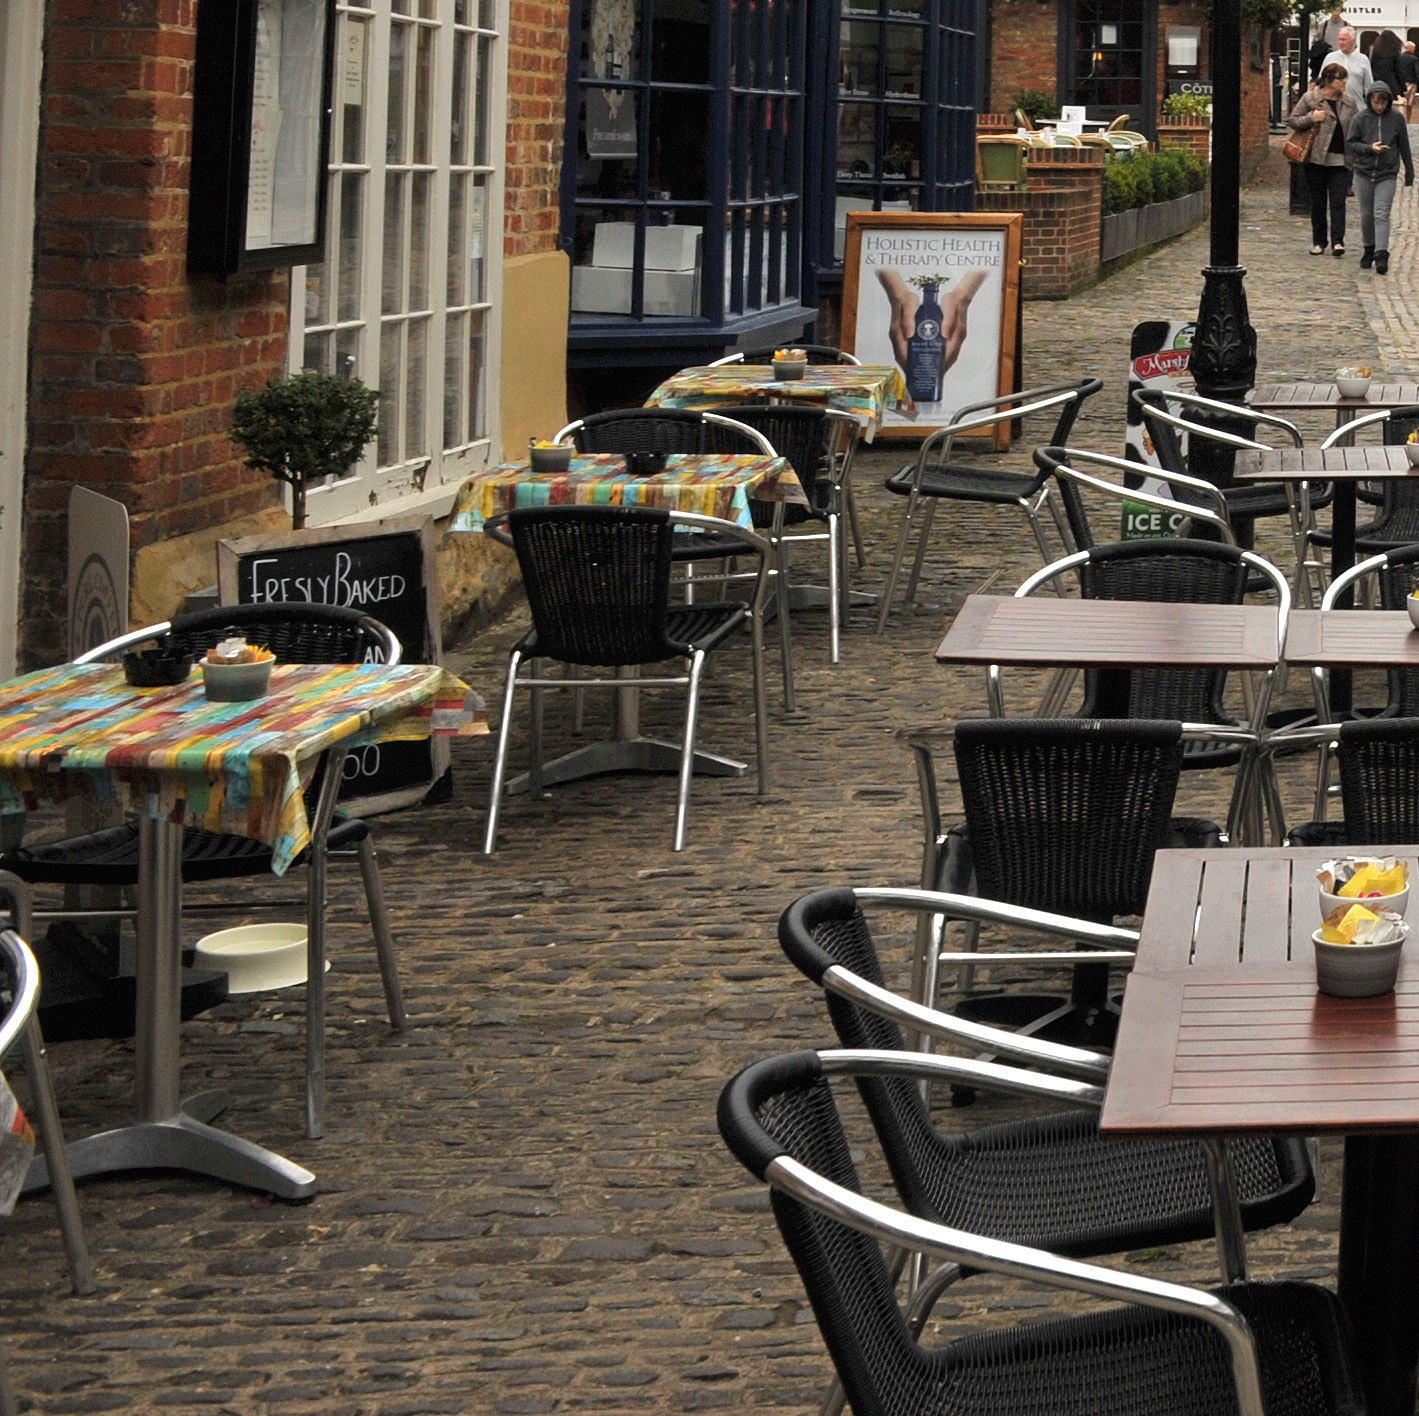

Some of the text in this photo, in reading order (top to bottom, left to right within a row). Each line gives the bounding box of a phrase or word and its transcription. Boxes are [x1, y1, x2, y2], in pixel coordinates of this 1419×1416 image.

[866, 237, 1000, 252] HOLISTIC HEALTH
[865, 253, 1000, 267] & THERAPY CENTRE
[1127, 514, 1162, 531] ICE
[332, 552, 406, 608] BAKED
